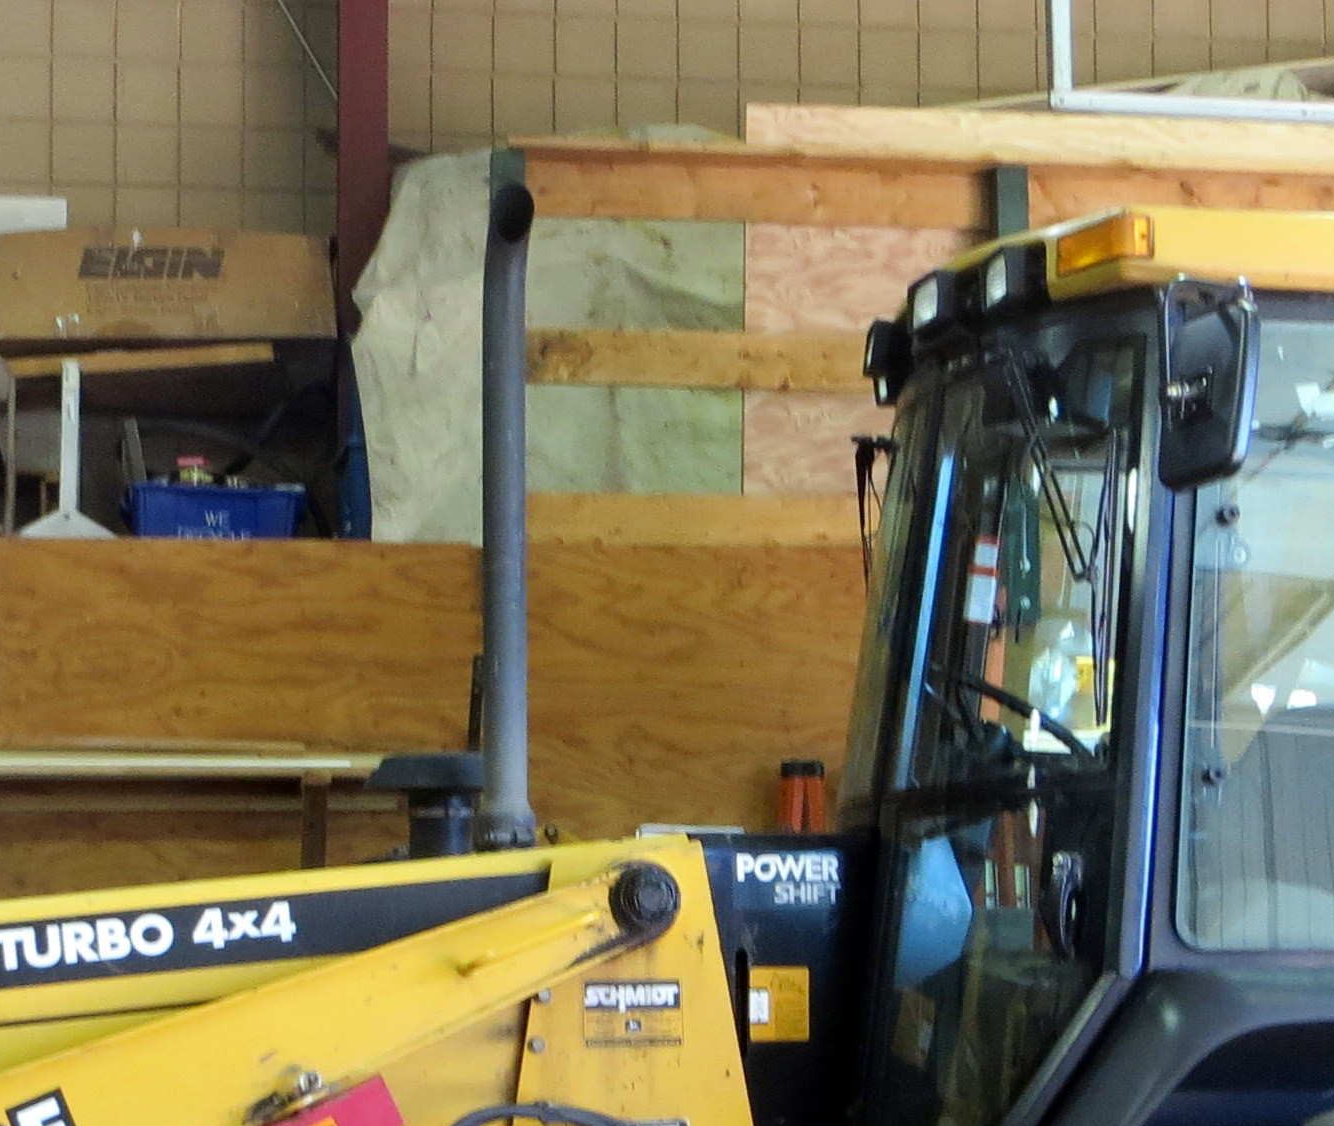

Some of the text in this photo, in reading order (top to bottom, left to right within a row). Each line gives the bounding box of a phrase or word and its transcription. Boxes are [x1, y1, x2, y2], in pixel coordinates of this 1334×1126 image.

[78, 246, 225, 279] ELGIN
[736, 852, 839, 883] POWER
[774, 881, 841, 905] SHIFT
[192, 900, 297, 949] 4x4
[584, 983, 679, 1014] SCHMIDT
